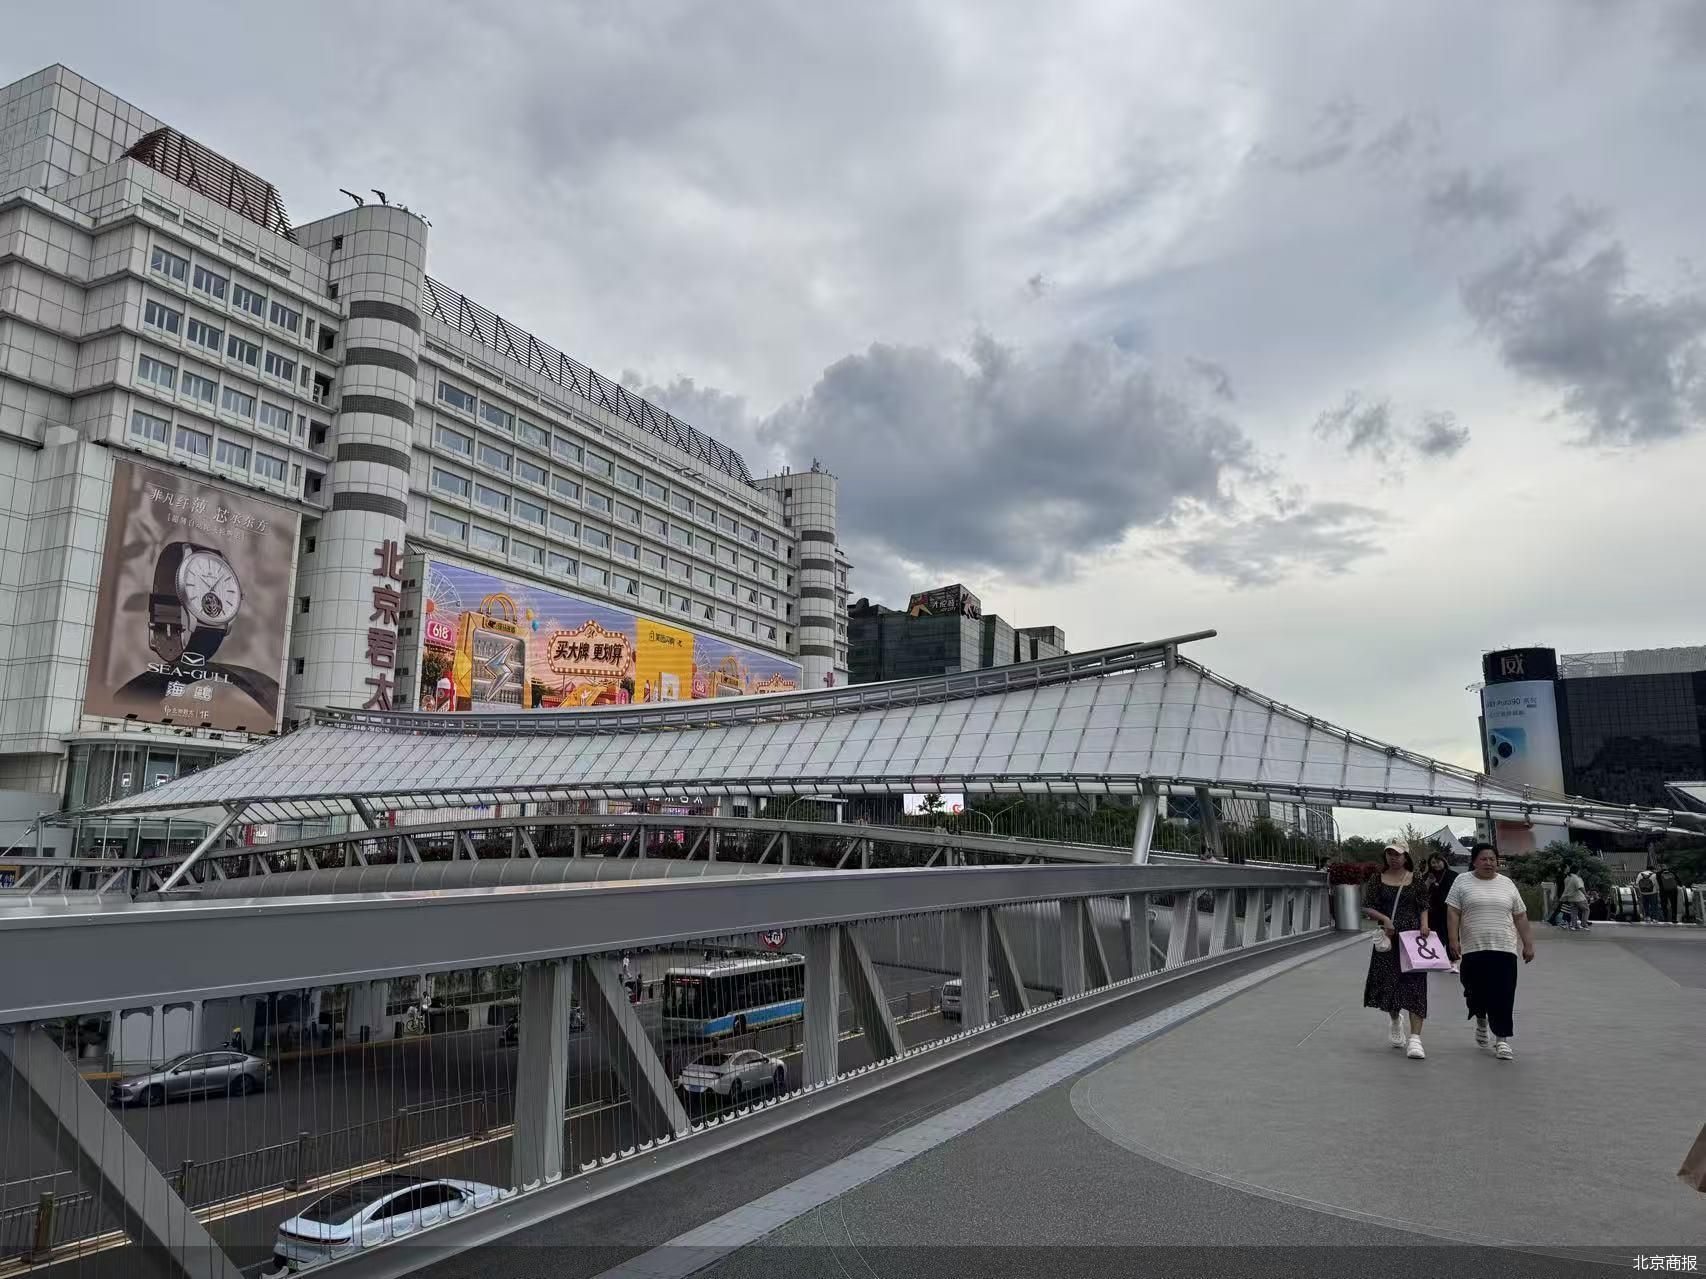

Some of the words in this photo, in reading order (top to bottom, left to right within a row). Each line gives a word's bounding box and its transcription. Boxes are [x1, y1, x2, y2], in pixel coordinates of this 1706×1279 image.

[151, 488, 208, 513] 非凡纤薄
[432, 623, 450, 640] 618
[553, 640, 589, 663] 买大牌
[592, 642, 625, 666] 更划算
[147, 662, 234, 685] SEA-GULL
